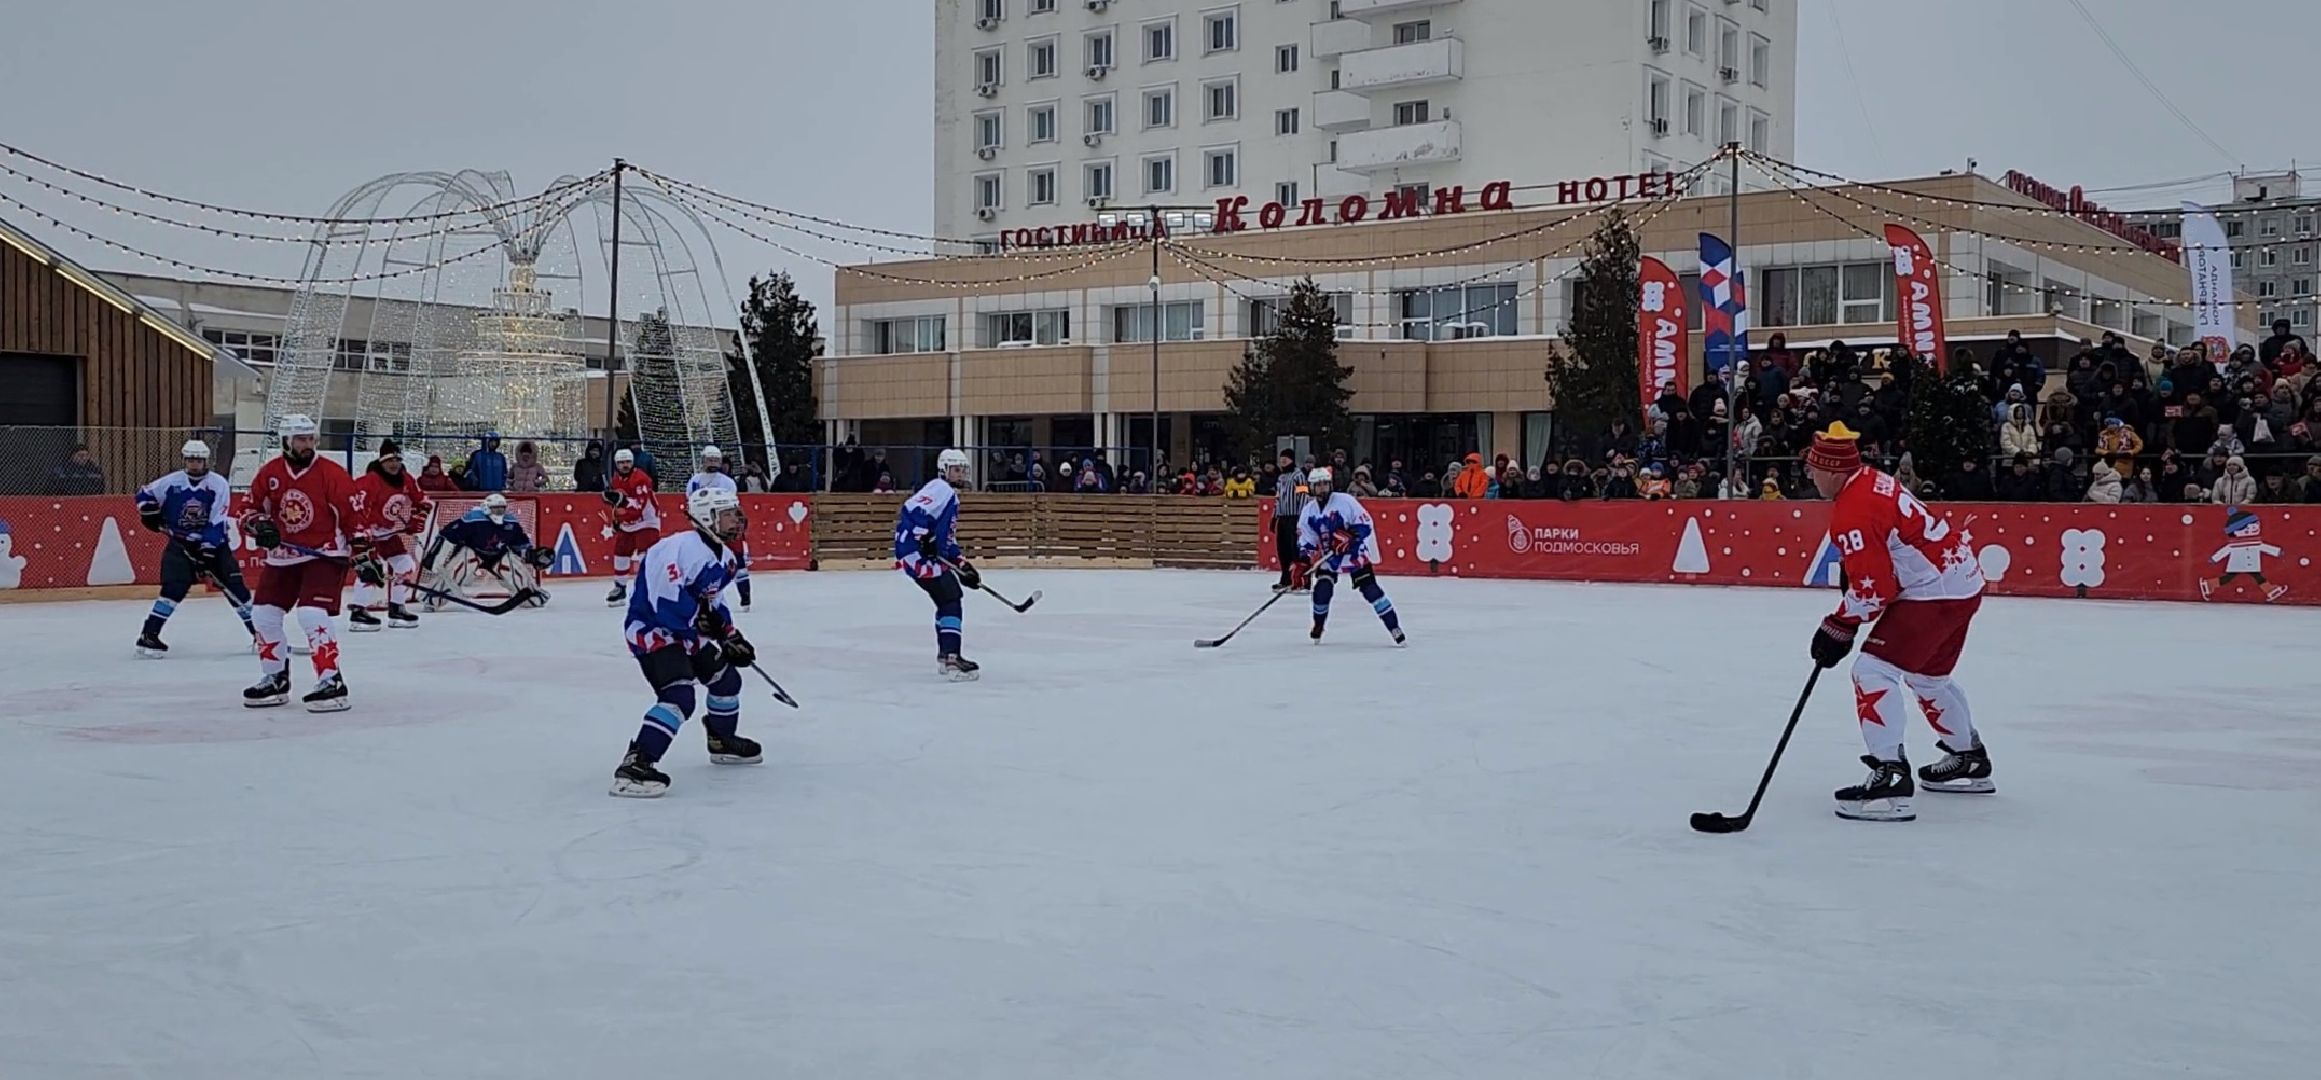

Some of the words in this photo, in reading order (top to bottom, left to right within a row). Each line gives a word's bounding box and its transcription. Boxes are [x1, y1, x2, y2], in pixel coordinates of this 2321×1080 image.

[1213, 181, 1513, 233] Коломна
[1558, 172, 1683, 204] HOTEL
[1534, 528, 1579, 539] ПАРКИ
[1838, 529, 1865, 556] 28
[1534, 541, 1640, 555] ПОДМОСКОВЬЯ
